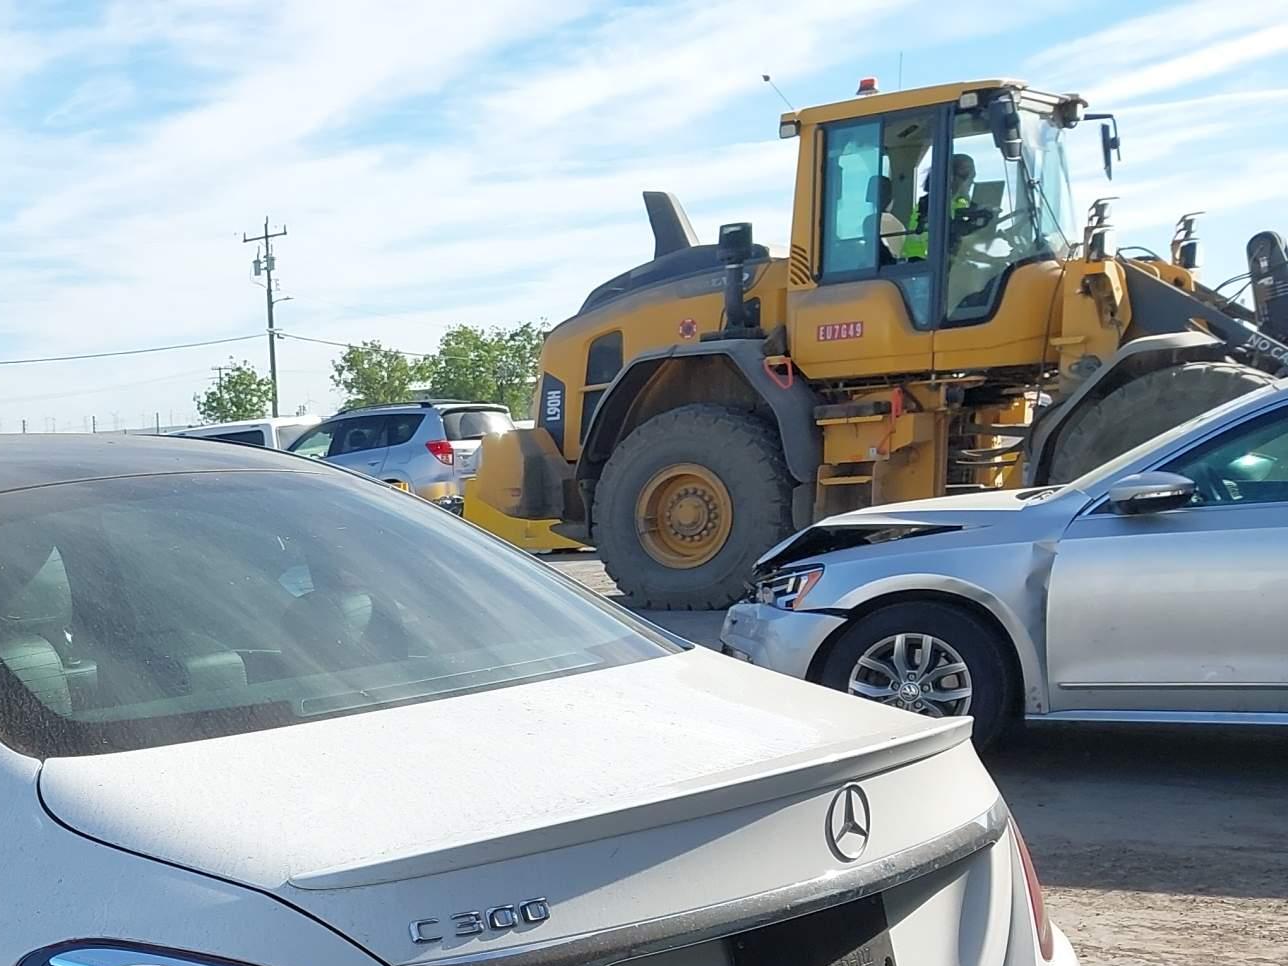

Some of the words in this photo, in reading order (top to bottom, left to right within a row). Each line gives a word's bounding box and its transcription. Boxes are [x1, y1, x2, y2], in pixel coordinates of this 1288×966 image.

[1247, 333, 1271, 351] NO
[546, 390, 561, 421] L90H
[408, 917, 443, 944] C
[450, 897, 551, 936] 300
